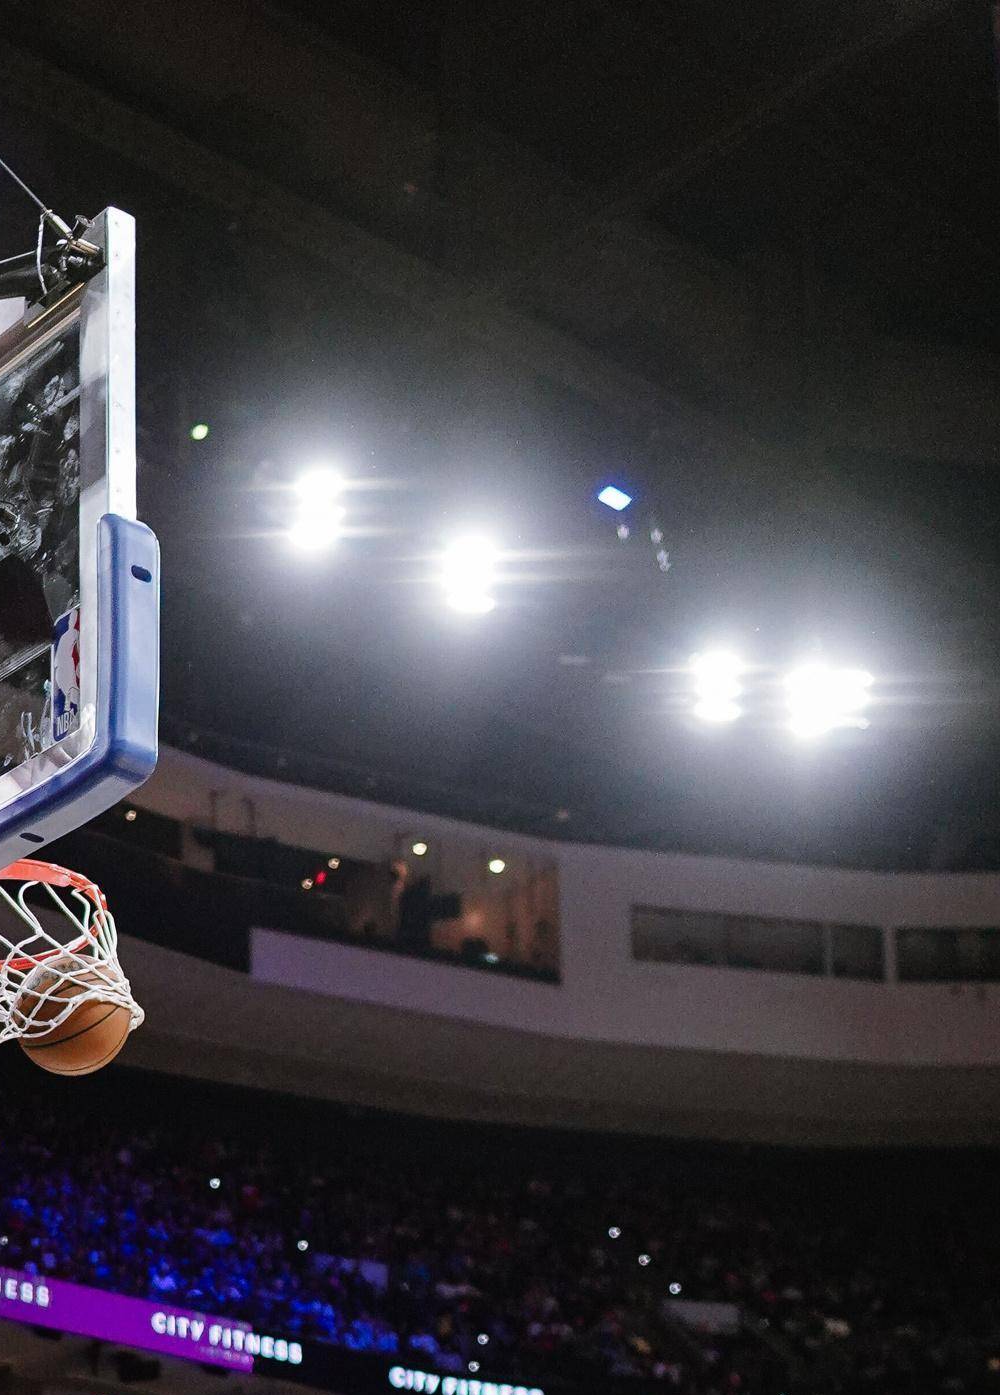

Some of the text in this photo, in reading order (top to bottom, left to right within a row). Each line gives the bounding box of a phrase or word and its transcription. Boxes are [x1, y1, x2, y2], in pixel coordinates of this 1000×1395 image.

[151, 1311, 204, 1342] CITY
[208, 1324, 302, 1365] FITNESS
[389, 1366, 440, 1395] CITY
